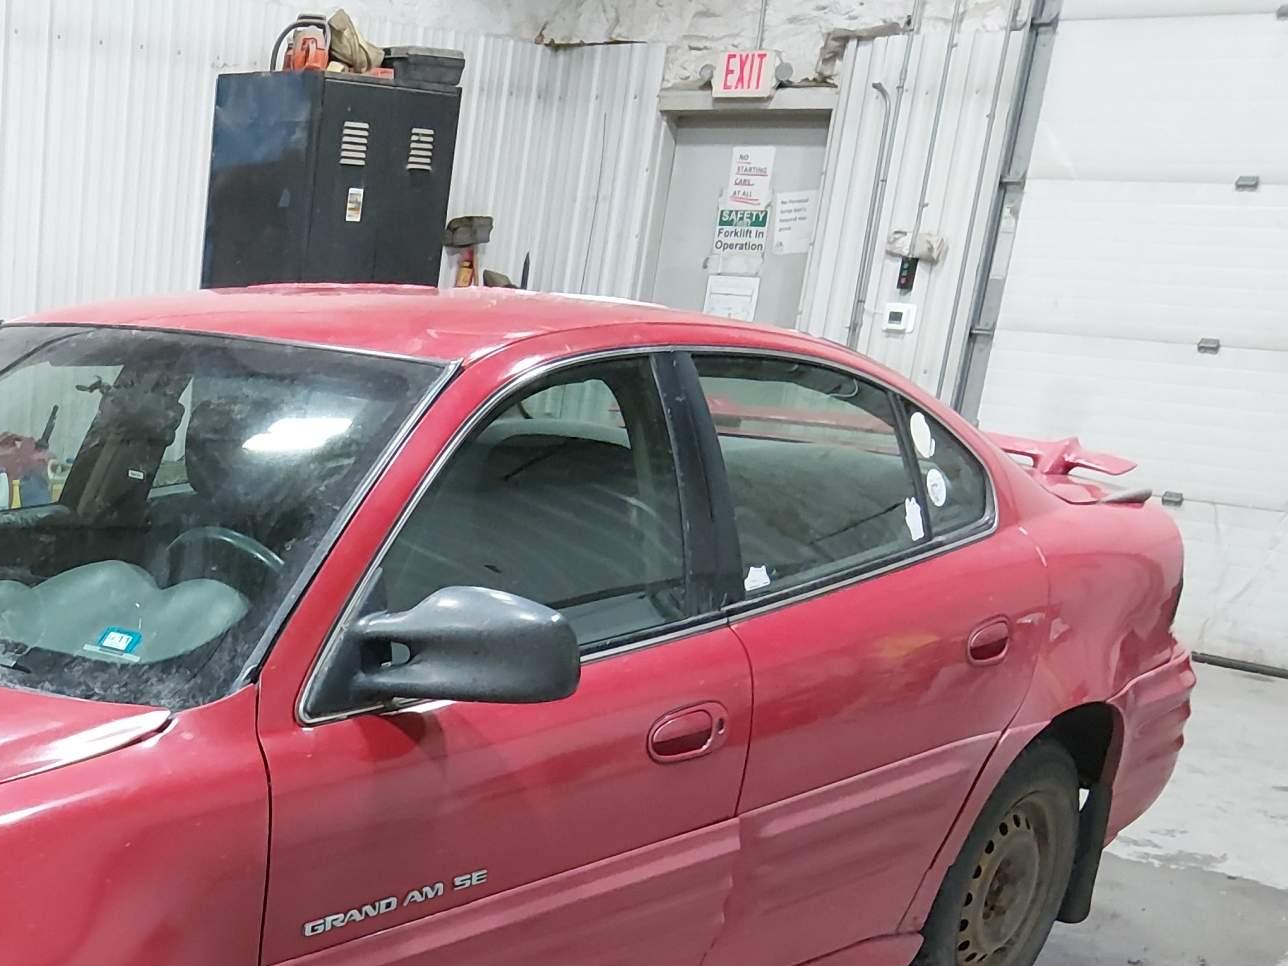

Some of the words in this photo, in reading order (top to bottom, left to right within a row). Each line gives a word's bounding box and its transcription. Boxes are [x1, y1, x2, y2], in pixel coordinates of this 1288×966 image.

[723, 53, 767, 90] EXIT
[721, 210, 766, 221] SAFETY
[717, 228, 752, 239] Forklift
[714, 240, 764, 252] Operation
[303, 896, 398, 937] GRAND
[403, 882, 444, 907] AM
[453, 869, 488, 891] SE
